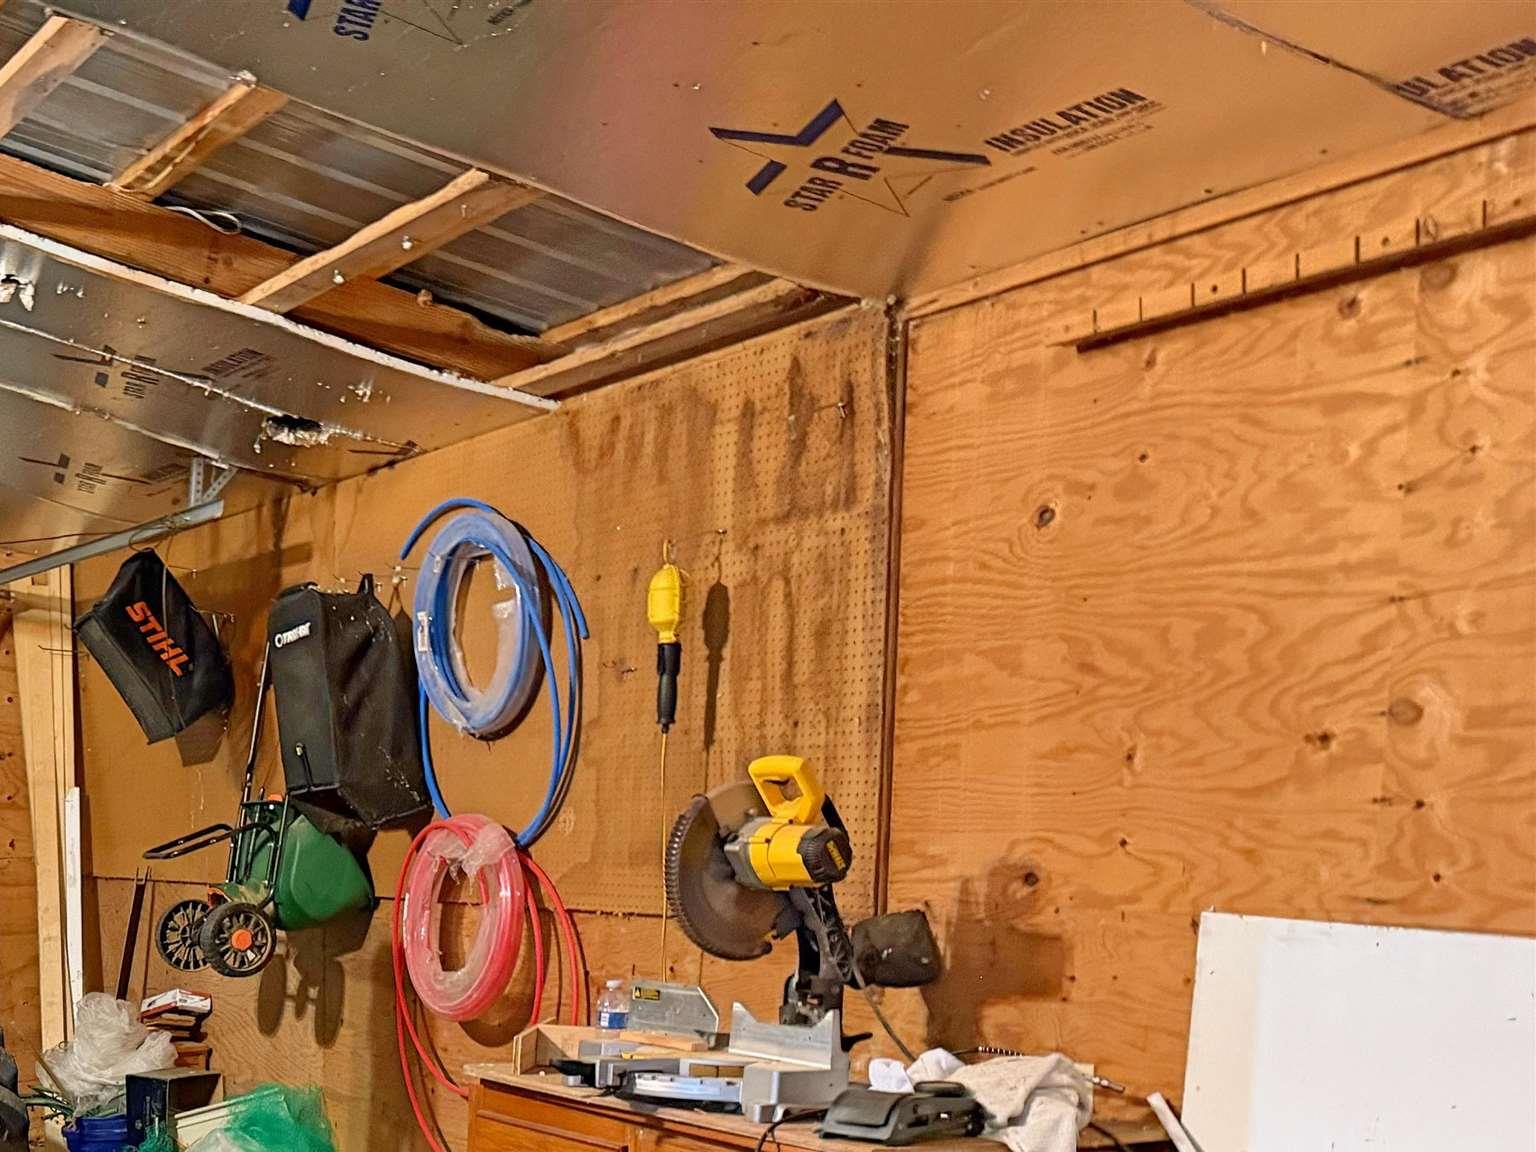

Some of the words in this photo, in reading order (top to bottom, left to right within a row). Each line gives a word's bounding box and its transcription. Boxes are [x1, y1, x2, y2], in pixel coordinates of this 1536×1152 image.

[841, 117, 910, 160] FOAM
[983, 88, 1149, 153] INSULATION
[809, 156, 881, 181] R
[783, 176, 844, 212] STAR
[125, 601, 190, 678] STIHL
